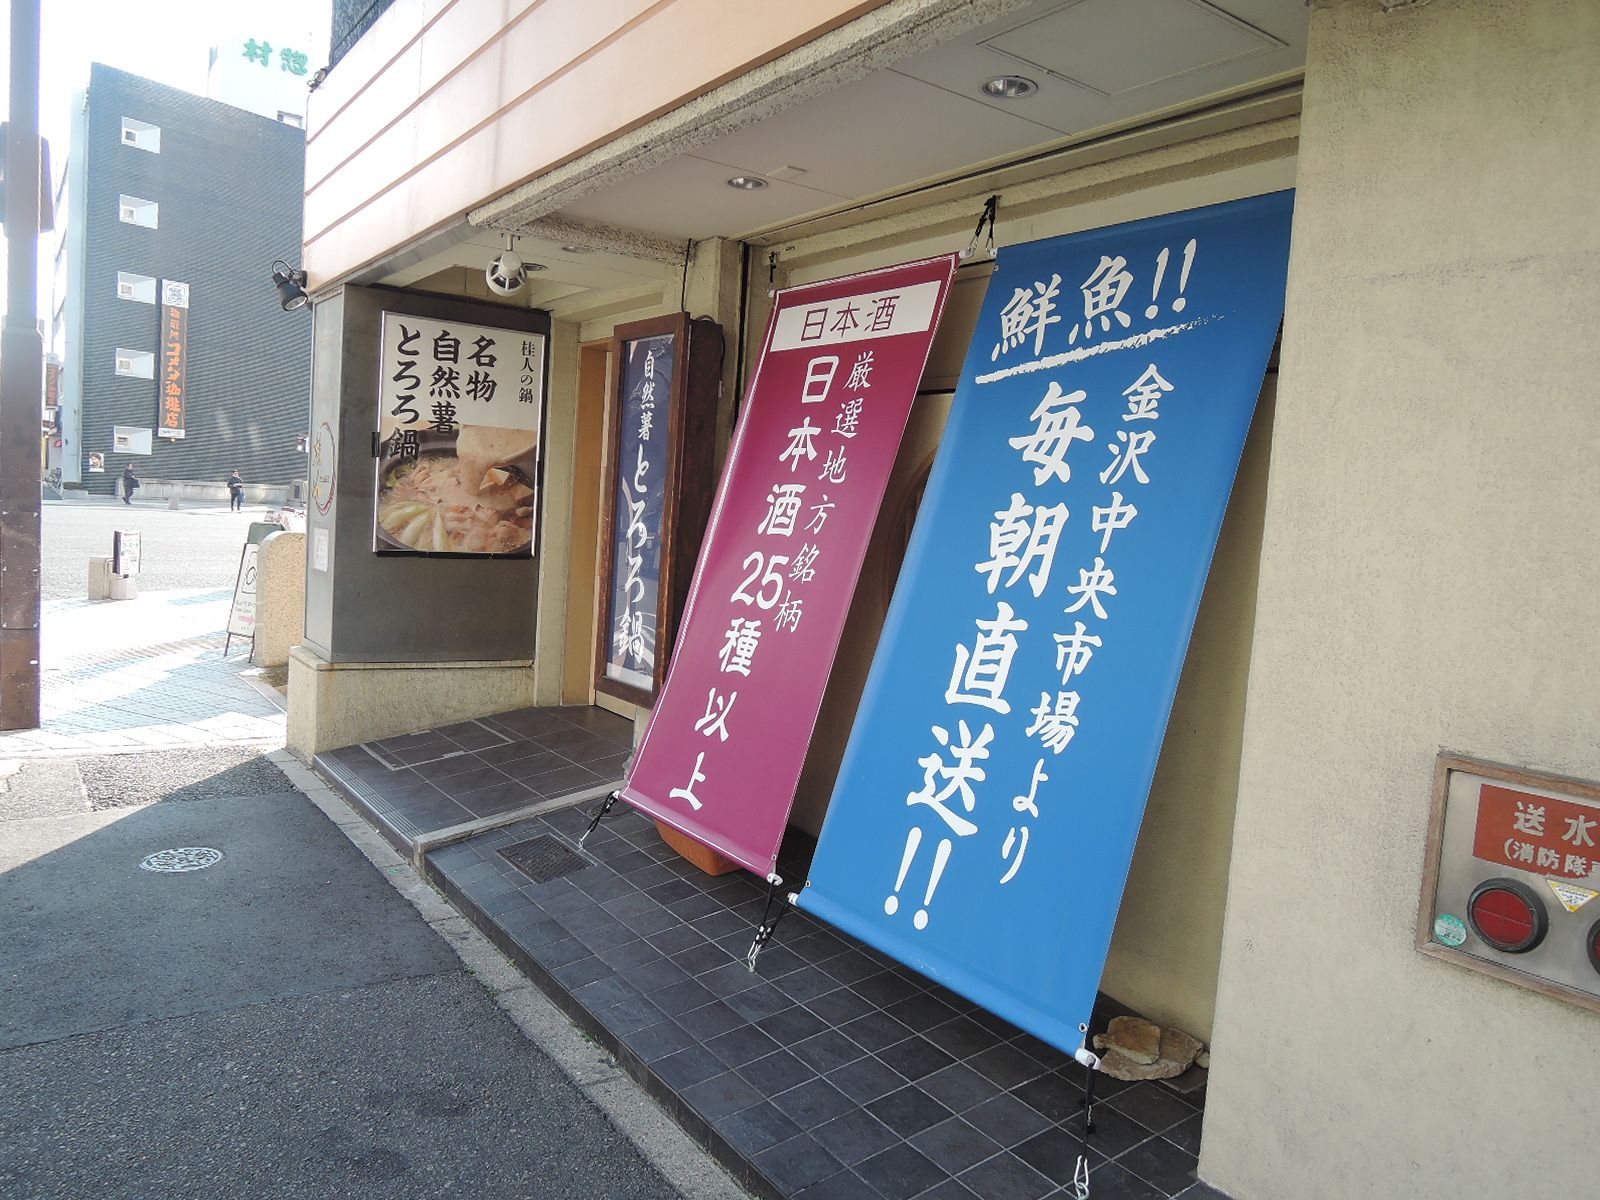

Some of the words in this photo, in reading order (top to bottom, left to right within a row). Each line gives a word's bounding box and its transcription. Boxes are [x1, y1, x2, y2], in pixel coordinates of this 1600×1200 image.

[465, 335, 497, 403] 名物
[801, 295, 902, 341] 日本酒
[388, 324, 421, 460] とろろ鍋
[428, 330, 461, 435] 自然薯
[518, 340, 535, 404] 桂人の鍋
[773, 351, 874, 633] 厳選地方銘柄
[669, 355, 839, 811] 日本酒25種以上
[1000, 364, 1174, 884] 金沢中央市場より
[884, 381, 1094, 930] 毎朝直送!!
[1504, 838, 1600, 876] (消防隊
[1513, 801, 1598, 847] 送水
